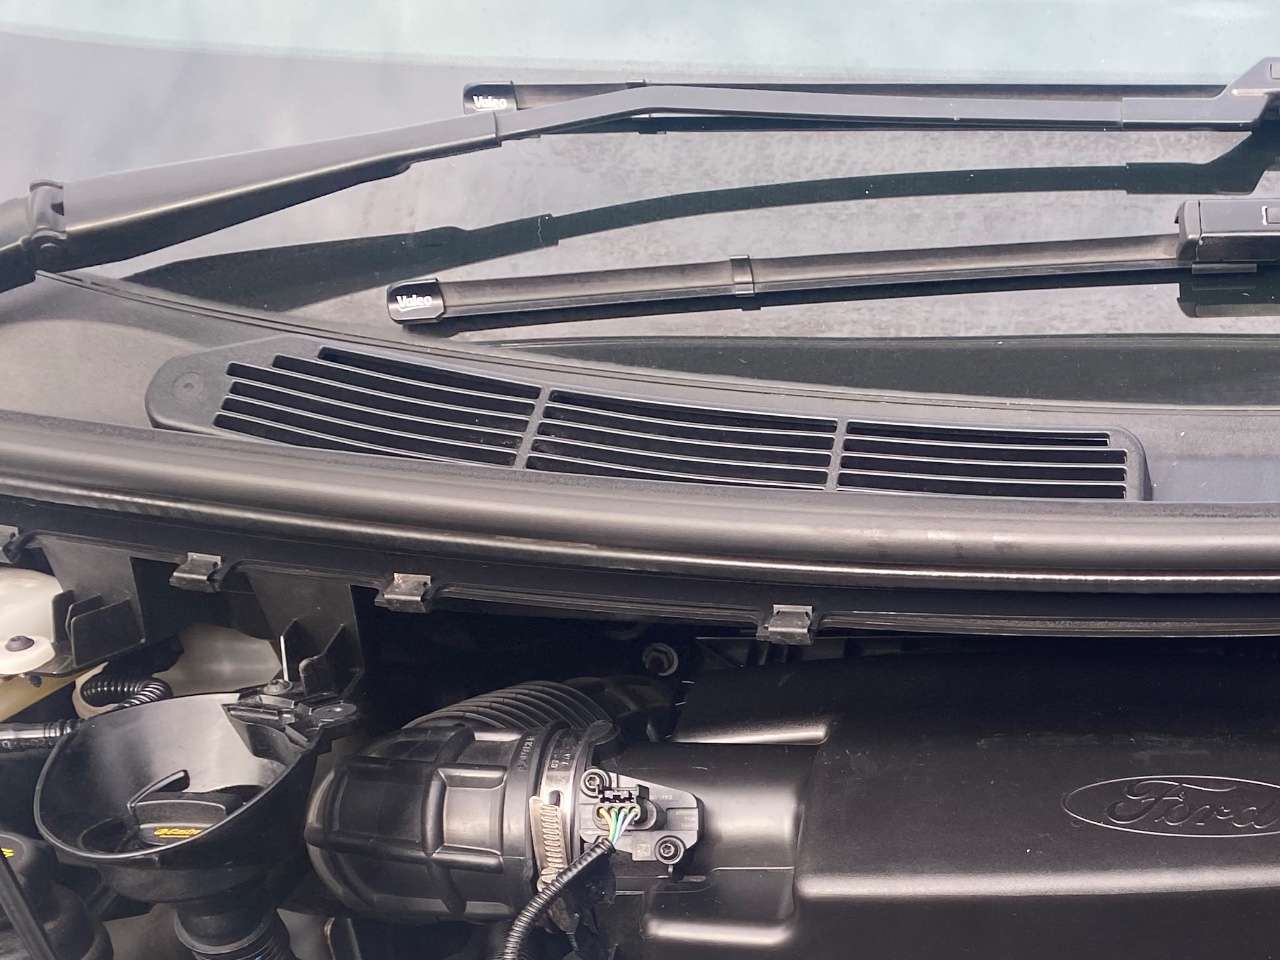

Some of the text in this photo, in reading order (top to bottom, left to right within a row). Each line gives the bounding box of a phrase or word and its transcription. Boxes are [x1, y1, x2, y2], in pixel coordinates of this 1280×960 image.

[472, 95, 507, 110] Valeo
[395, 294, 433, 311] Valeo
[1104, 779, 1280, 829] Ford
